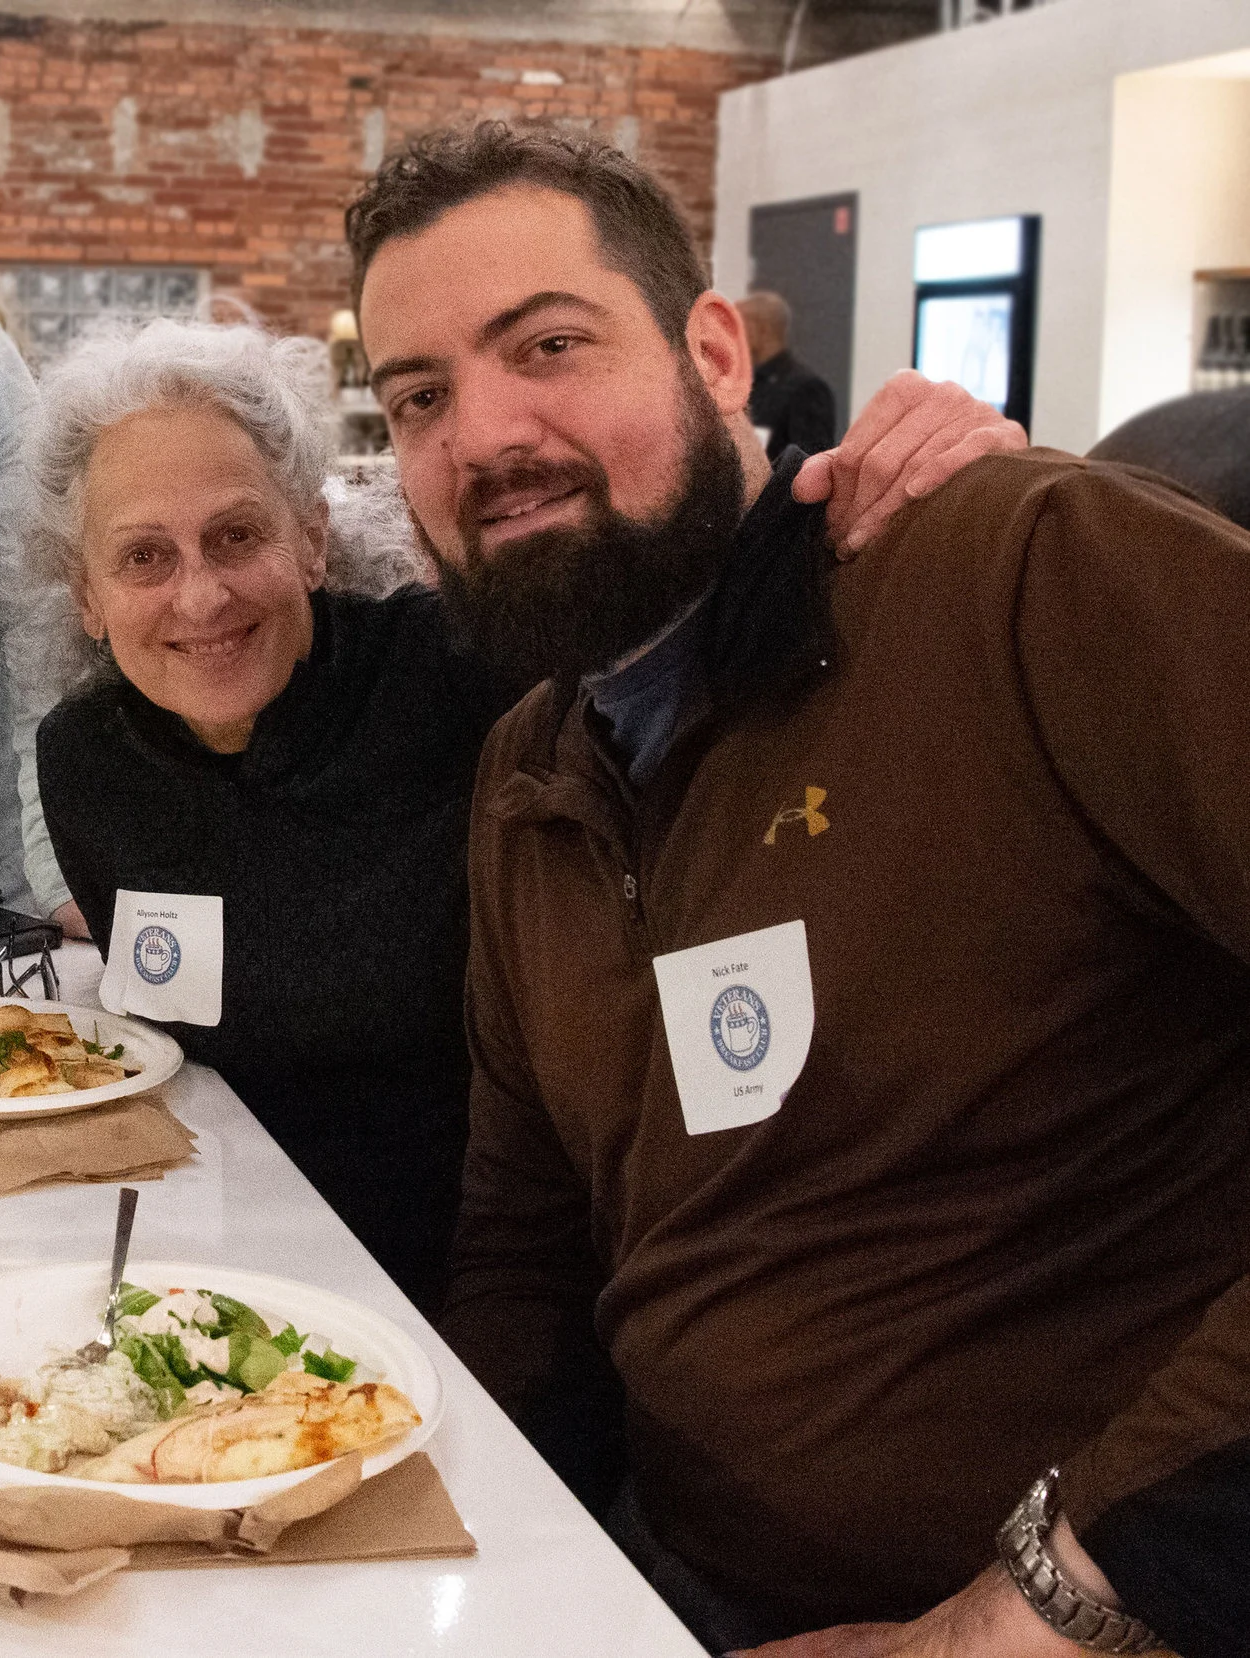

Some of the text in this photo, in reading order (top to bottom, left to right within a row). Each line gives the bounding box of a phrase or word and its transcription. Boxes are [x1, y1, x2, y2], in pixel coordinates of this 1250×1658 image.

[136, 909, 178, 919] Allyson Holtz
[137, 928, 177, 948] VETERANS
[711, 962, 749, 977] Nick Fate
[713, 989, 761, 1019] VETERANS
[733, 1084, 764, 1097] US Army
